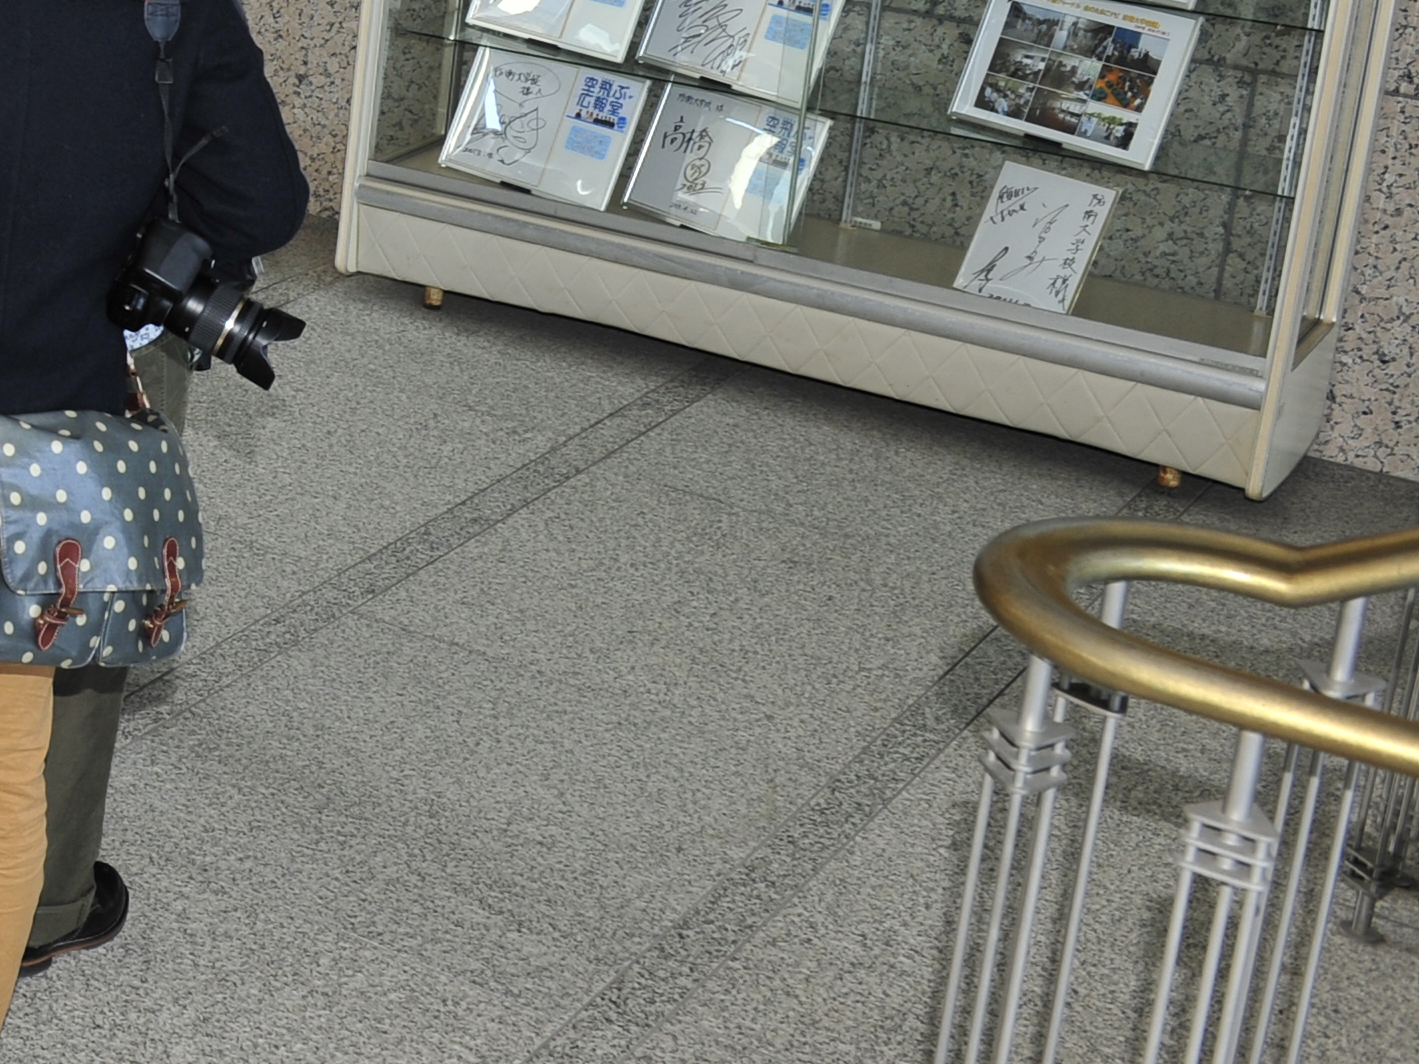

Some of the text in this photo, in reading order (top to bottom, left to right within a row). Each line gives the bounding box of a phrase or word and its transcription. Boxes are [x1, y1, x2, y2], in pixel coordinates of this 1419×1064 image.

[581, 76, 634, 100] 空飛ぶ
[576, 92, 624, 117] 広報室
